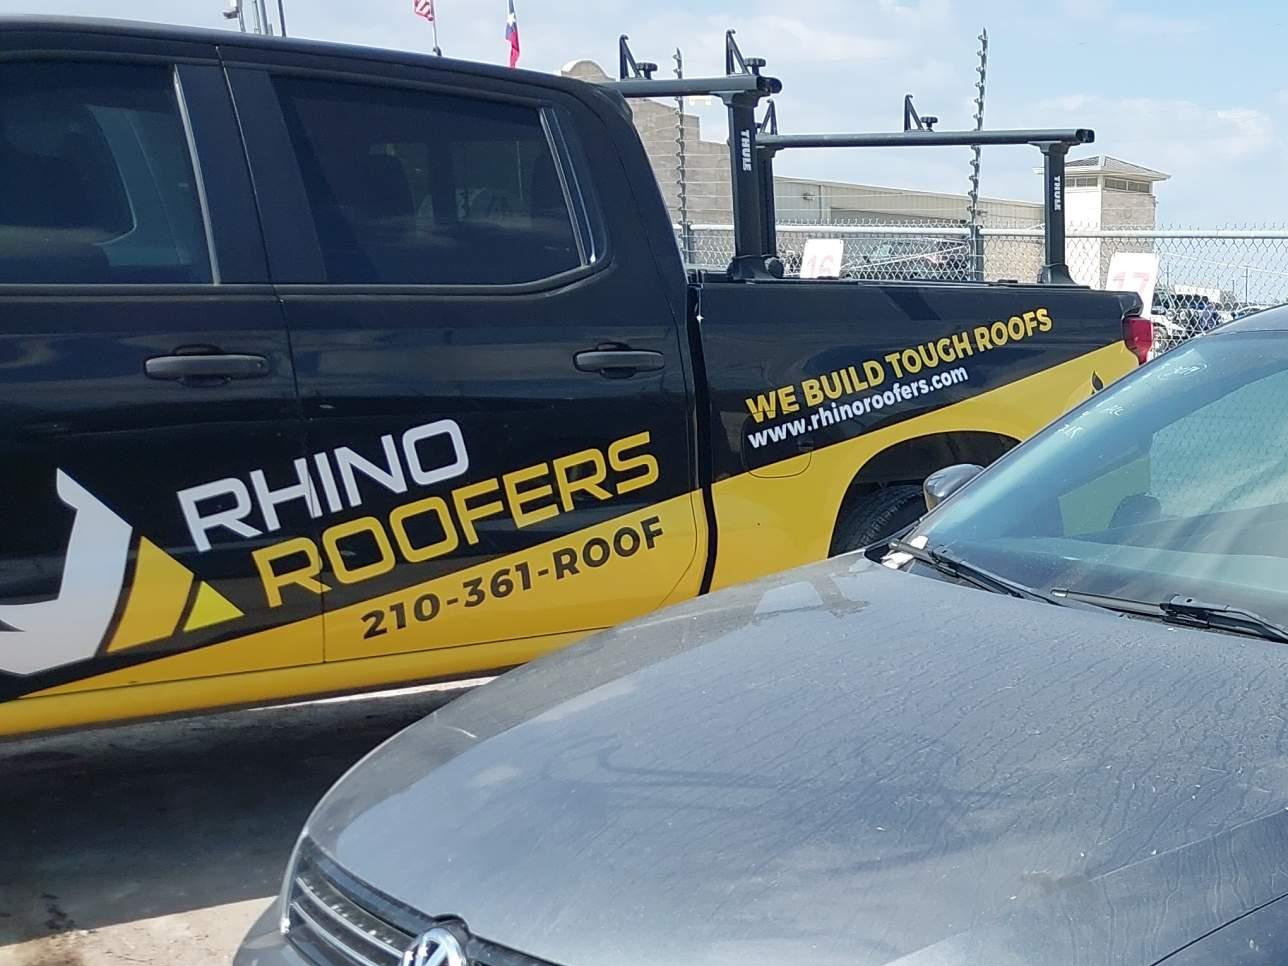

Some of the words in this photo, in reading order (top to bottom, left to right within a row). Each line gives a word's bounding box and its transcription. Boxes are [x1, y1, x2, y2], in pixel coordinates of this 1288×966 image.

[741, 130, 751, 170] THULE
[745, 385, 799, 423] WE
[801, 360, 884, 407] BUILD
[885, 331, 974, 378] TOUGH
[974, 307, 1053, 352] ROOFS
[747, 365, 969, 449] www.rhinoroofers.com
[177, 419, 469, 552] RHINO
[252, 431, 660, 608] ROOFERS
[361, 516, 664, 640] 210-361-ROOF
